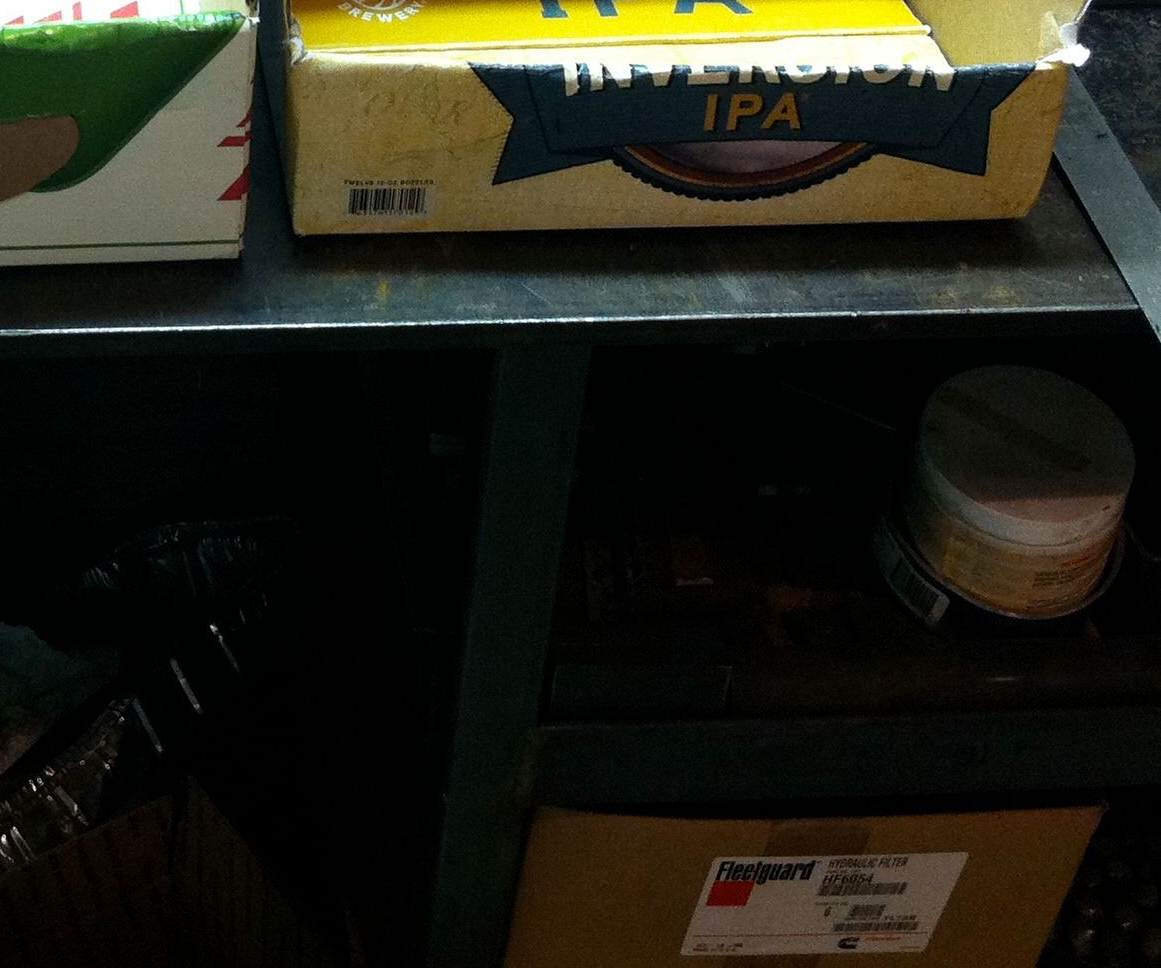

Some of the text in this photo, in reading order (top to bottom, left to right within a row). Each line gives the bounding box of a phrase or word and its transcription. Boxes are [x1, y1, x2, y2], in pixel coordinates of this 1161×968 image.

[337, 0, 425, 24] BREWERY
[703, 92, 802, 132] IPA
[715, 860, 817, 885] Fleetguard
